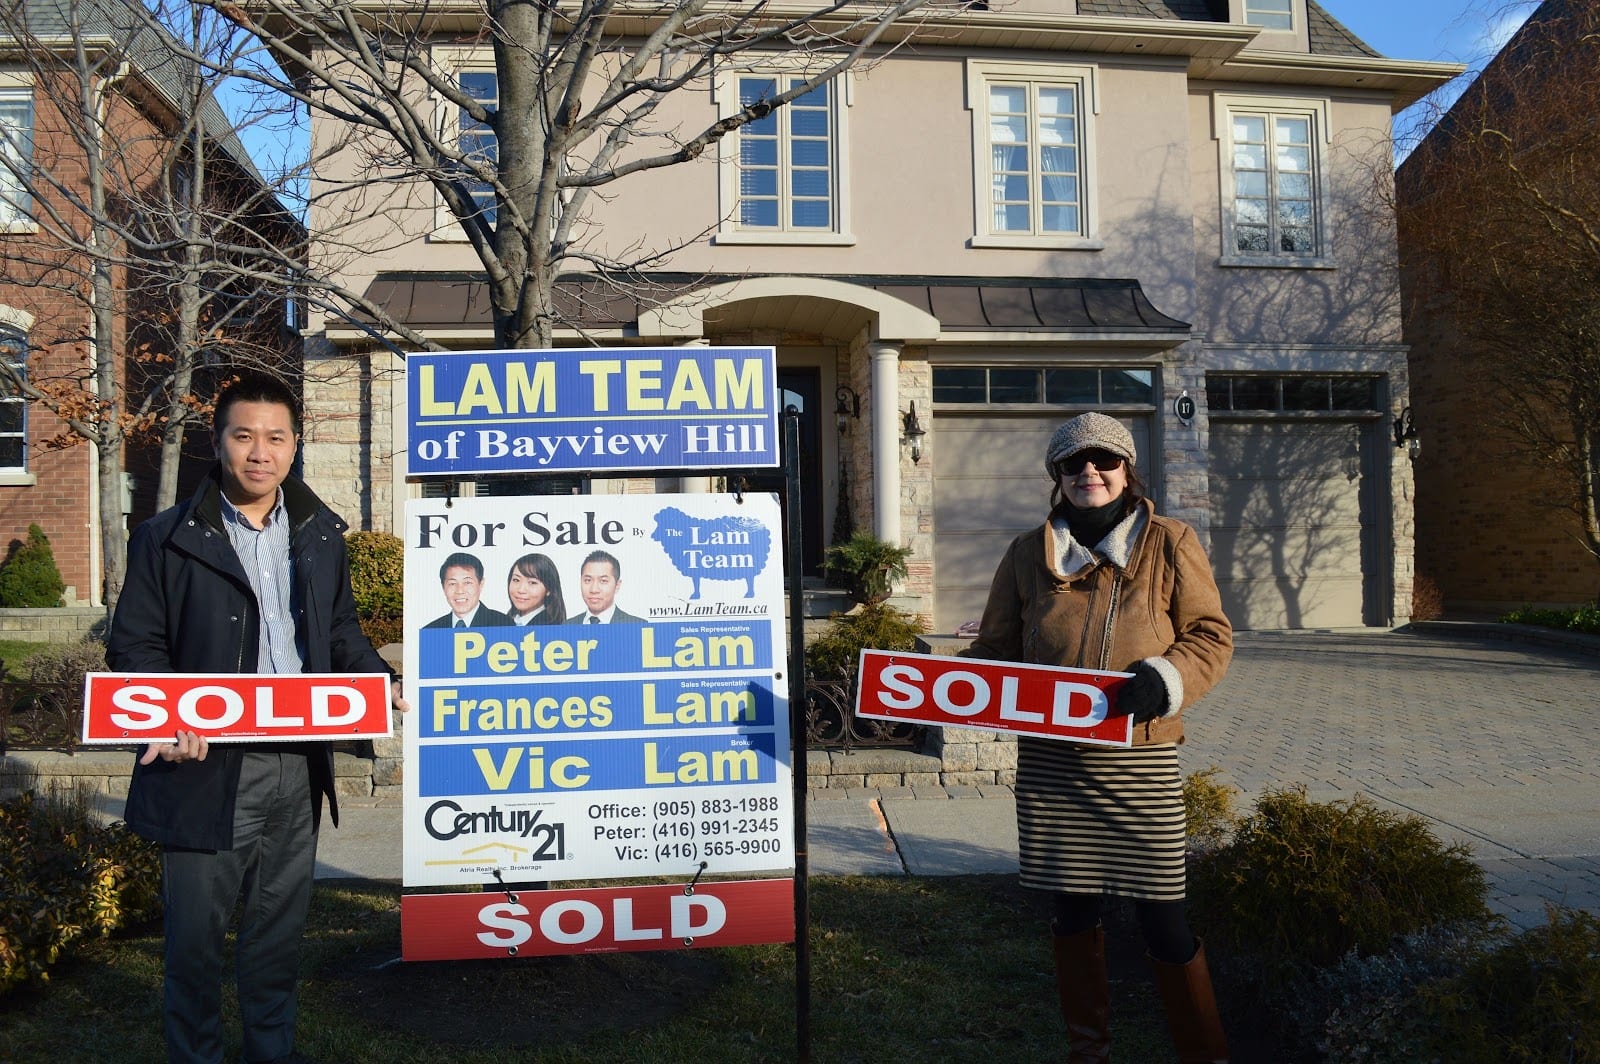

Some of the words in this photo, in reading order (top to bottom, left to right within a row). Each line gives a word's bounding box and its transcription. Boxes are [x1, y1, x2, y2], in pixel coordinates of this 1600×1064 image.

[419, 361, 557, 417] LAM
[579, 358, 765, 412] TEAM
[1182, 402, 1190, 414] 17
[416, 430, 466, 461] of
[475, 427, 668, 464] Bayview
[682, 424, 767, 454] Hill
[415, 513, 505, 549] For
[522, 511, 625, 546] Sale
[632, 527, 646, 538] By
[665, 528, 683, 538] The
[691, 526, 749, 546] Lam
[683, 550, 754, 569] Team
[649, 601, 769, 618] www.LamTeam.ca
[680, 626, 699, 634] Sales
[700, 625, 750, 634] Representative
[453, 631, 598, 674] Peter
[641, 627, 755, 669] Lam
[110, 685, 367, 730] SOLD
[433, 688, 613, 732] Frances
[642, 683, 757, 726] Lam
[877, 664, 1109, 728] SOLD
[730, 739, 754, 747] Broker
[472, 745, 591, 791] Vic
[644, 742, 759, 785] Lam
[424, 800, 544, 841] Century
[588, 803, 646, 820] Office:
[653, 800, 696, 820] (905)
[701, 796, 779, 815] 883-1988
[531, 823, 565, 862] 21
[594, 825, 646, 841] Peter:
[652, 821, 695, 841] (416)
[701, 818, 779, 836] 991-2345
[615, 845, 648, 861] Vic:
[655, 842, 698, 862] (416)
[704, 838, 781, 857] 565-9900
[476, 893, 727, 948] SOLD
